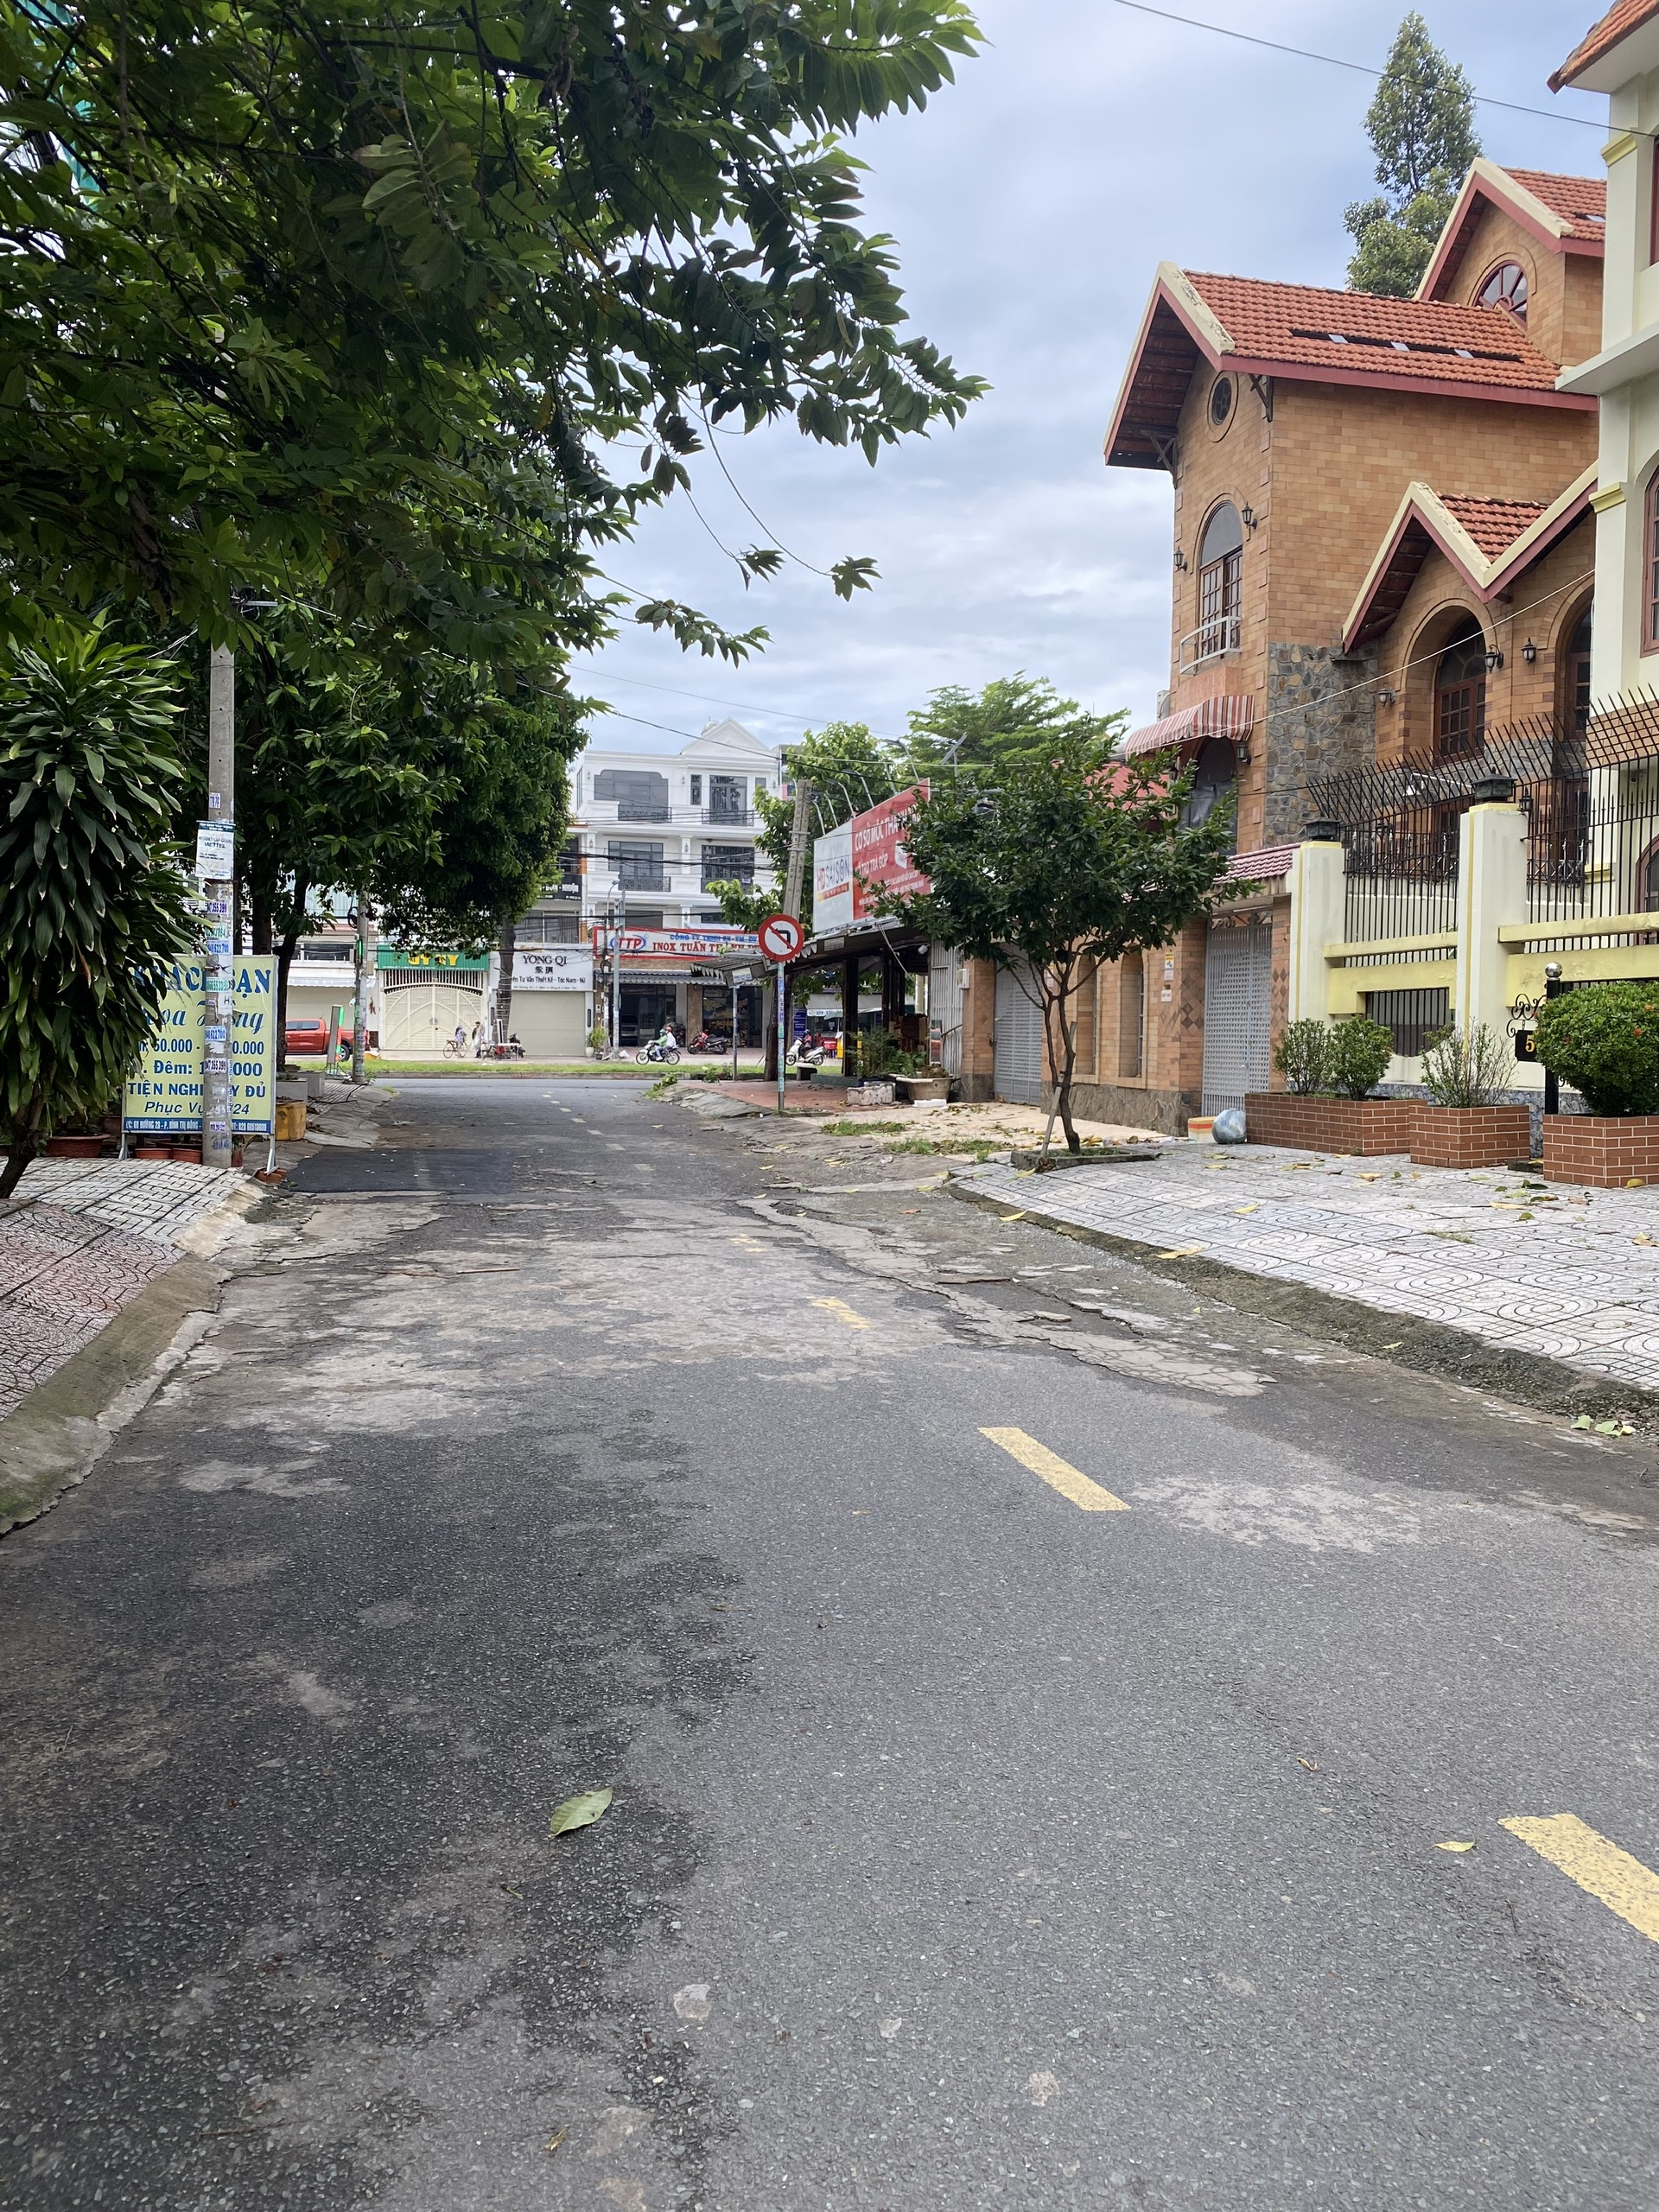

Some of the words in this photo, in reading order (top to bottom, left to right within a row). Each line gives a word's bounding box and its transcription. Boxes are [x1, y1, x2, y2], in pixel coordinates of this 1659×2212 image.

[653, 943, 676, 951] INOX
[680, 941, 706, 952] TUẤN
[523, 955, 552, 964] YONG
[555, 956, 567, 966] QI
[154, 1060, 192, 1075] Đêm:
[127, 1079, 162, 1097] TIỆN
[245, 1081, 266, 1098] ĐỦ
[144, 1102, 182, 1116] Phục
